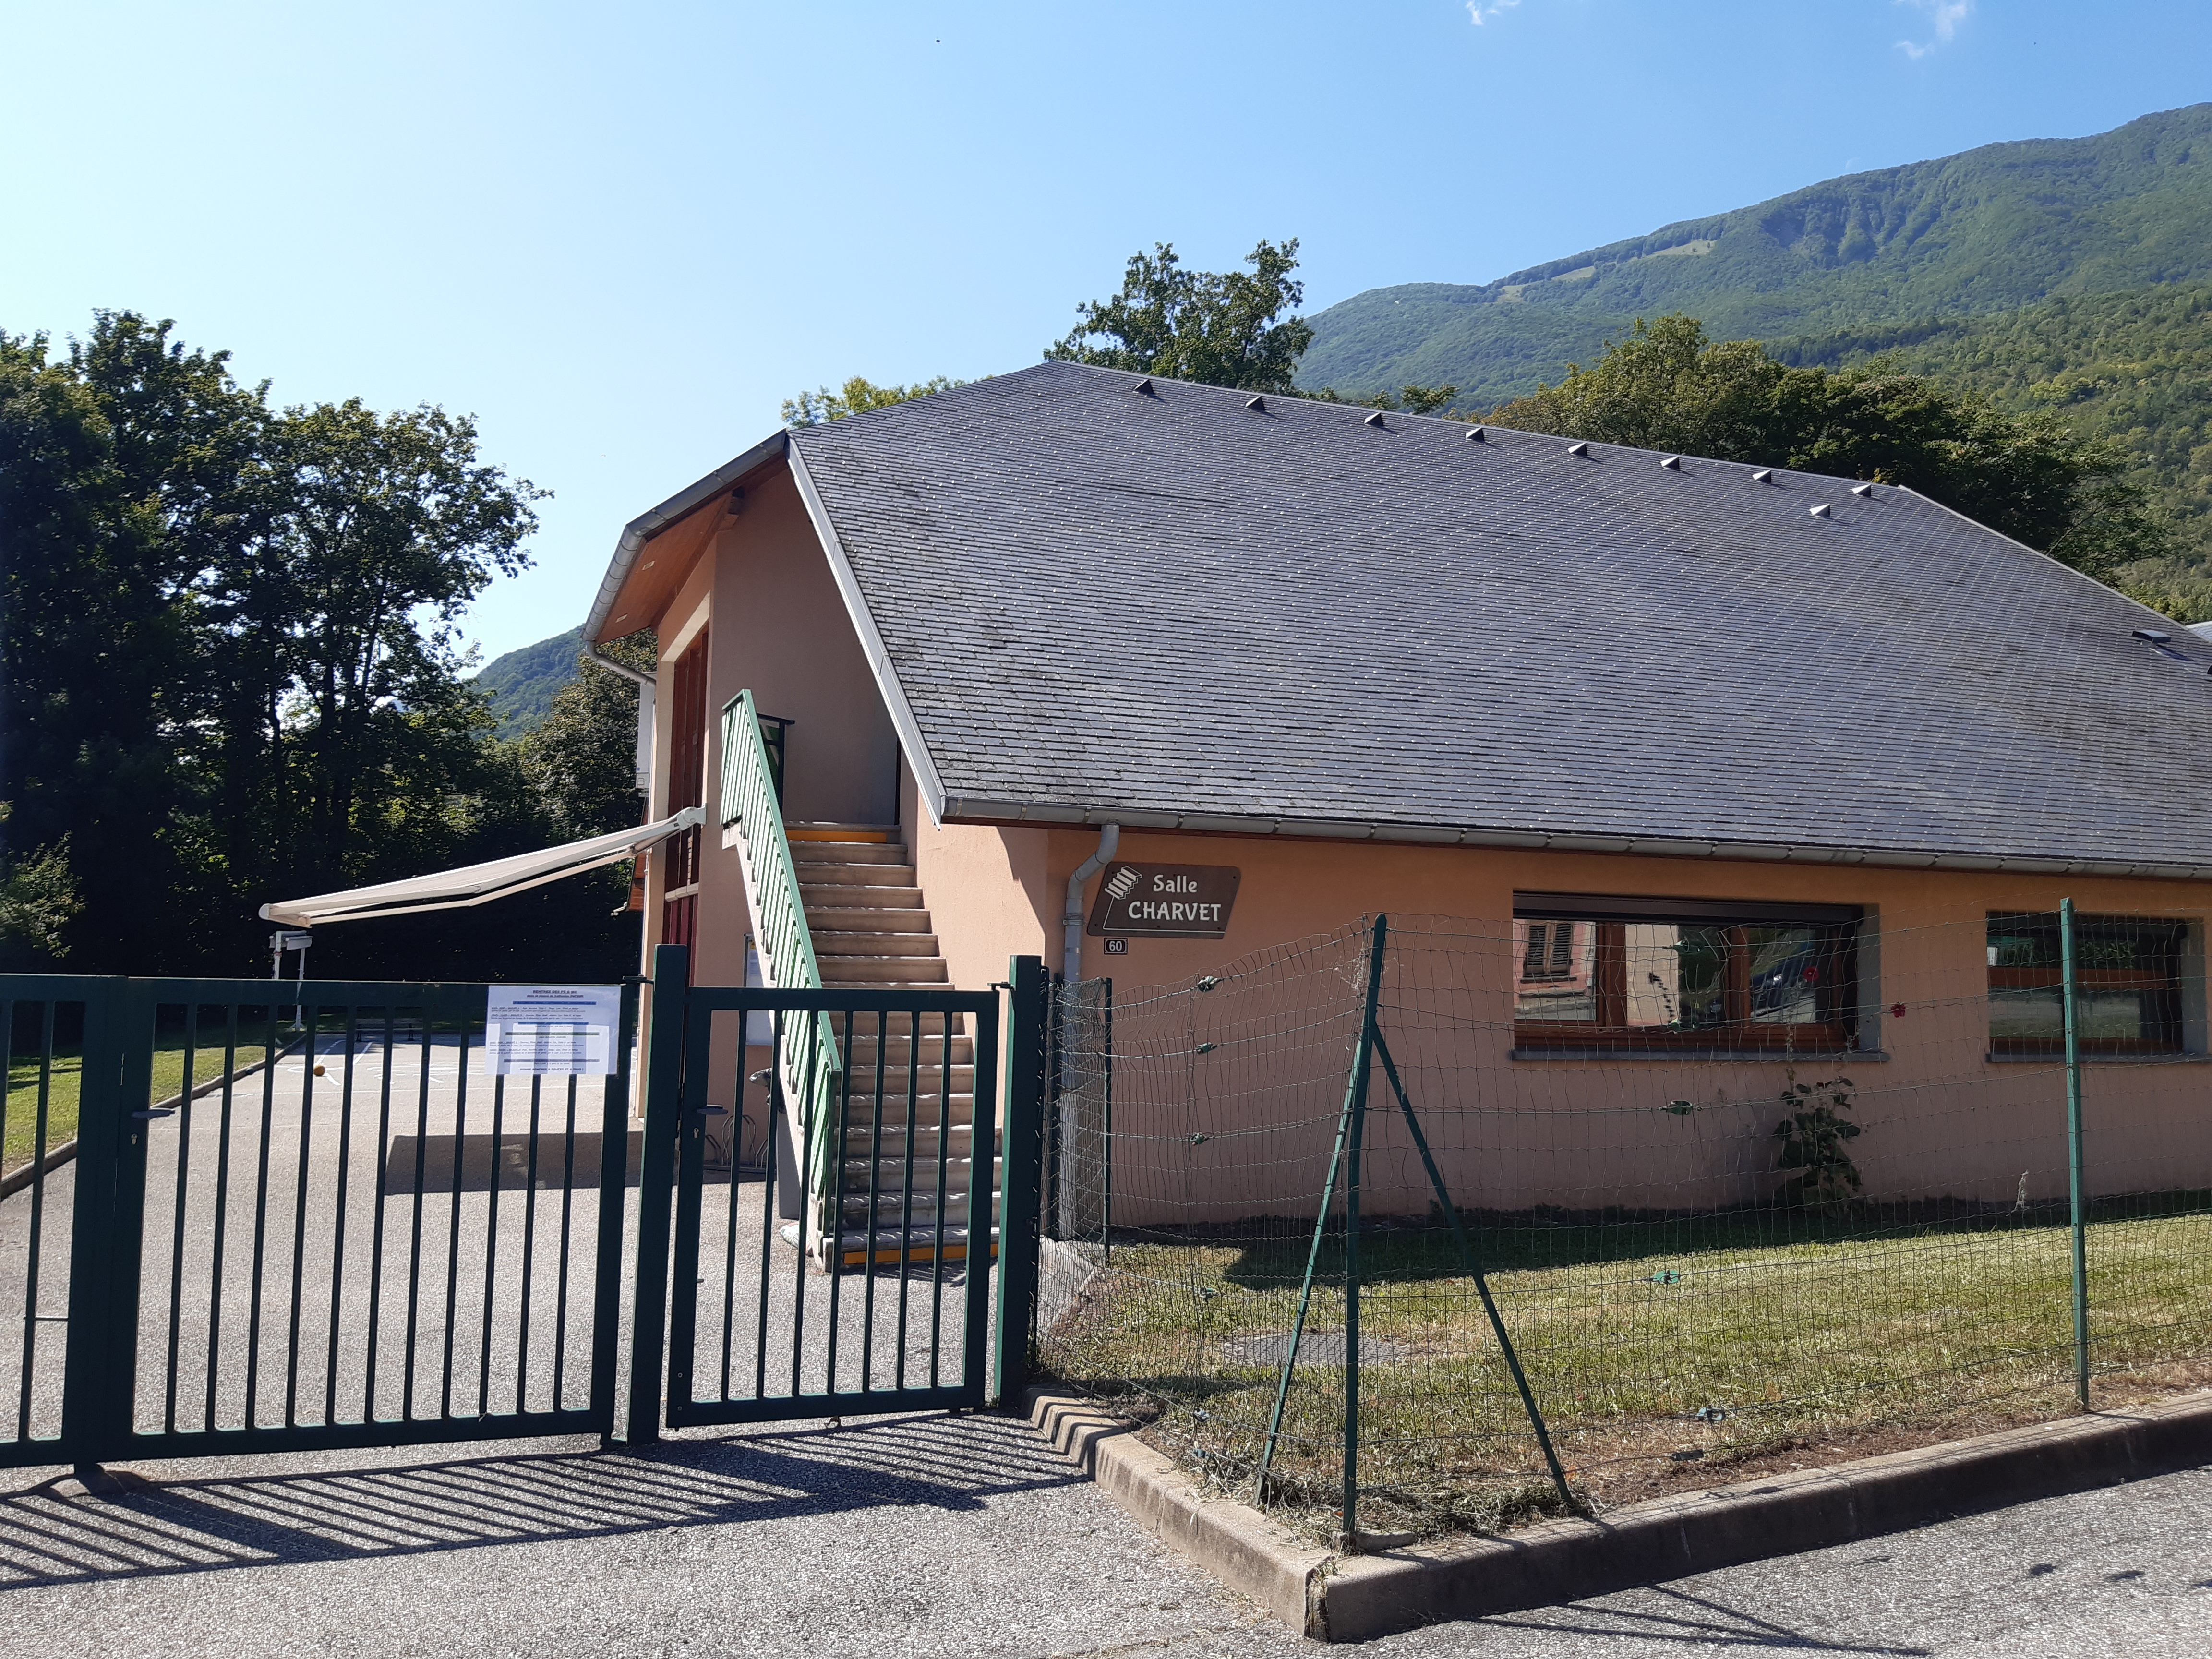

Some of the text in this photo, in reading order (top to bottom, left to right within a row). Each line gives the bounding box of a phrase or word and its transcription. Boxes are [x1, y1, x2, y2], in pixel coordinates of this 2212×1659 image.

[1153, 874, 1197, 893] Salle
[1128, 901, 1221, 922] CHARVET
[1109, 940, 1122, 952] 60
